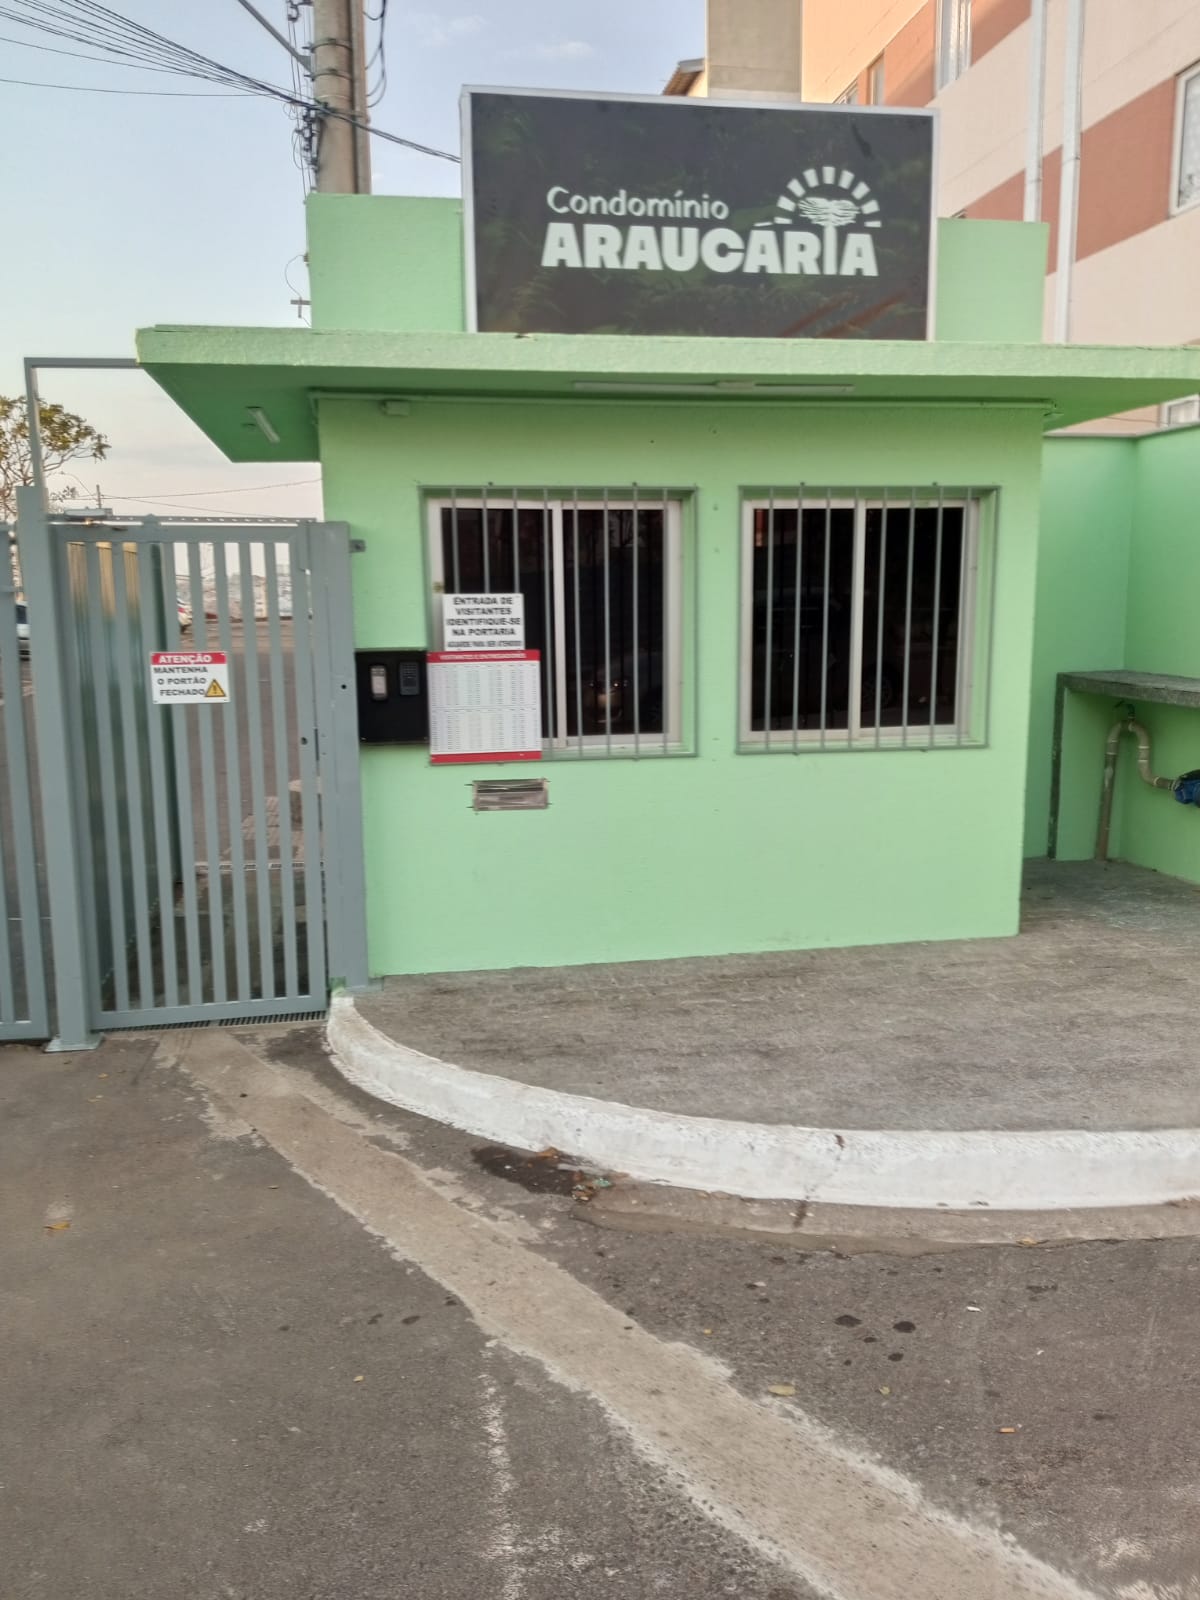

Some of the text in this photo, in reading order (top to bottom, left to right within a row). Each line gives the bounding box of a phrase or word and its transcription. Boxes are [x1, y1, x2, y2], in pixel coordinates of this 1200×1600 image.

[546, 186, 729, 220] Condomínio
[541, 221, 879, 277] ARAUCÁRIA
[453, 596, 513, 605] ENTRADA DE
[455, 607, 513, 615] VISITANTES
[447, 617, 521, 626] IDENTIFIQUE-SE
[452, 628, 516, 636] NA PORTARIA
[160, 654, 212, 664] ATENÇÃO
[167, 676, 207, 685] PORTÃO
